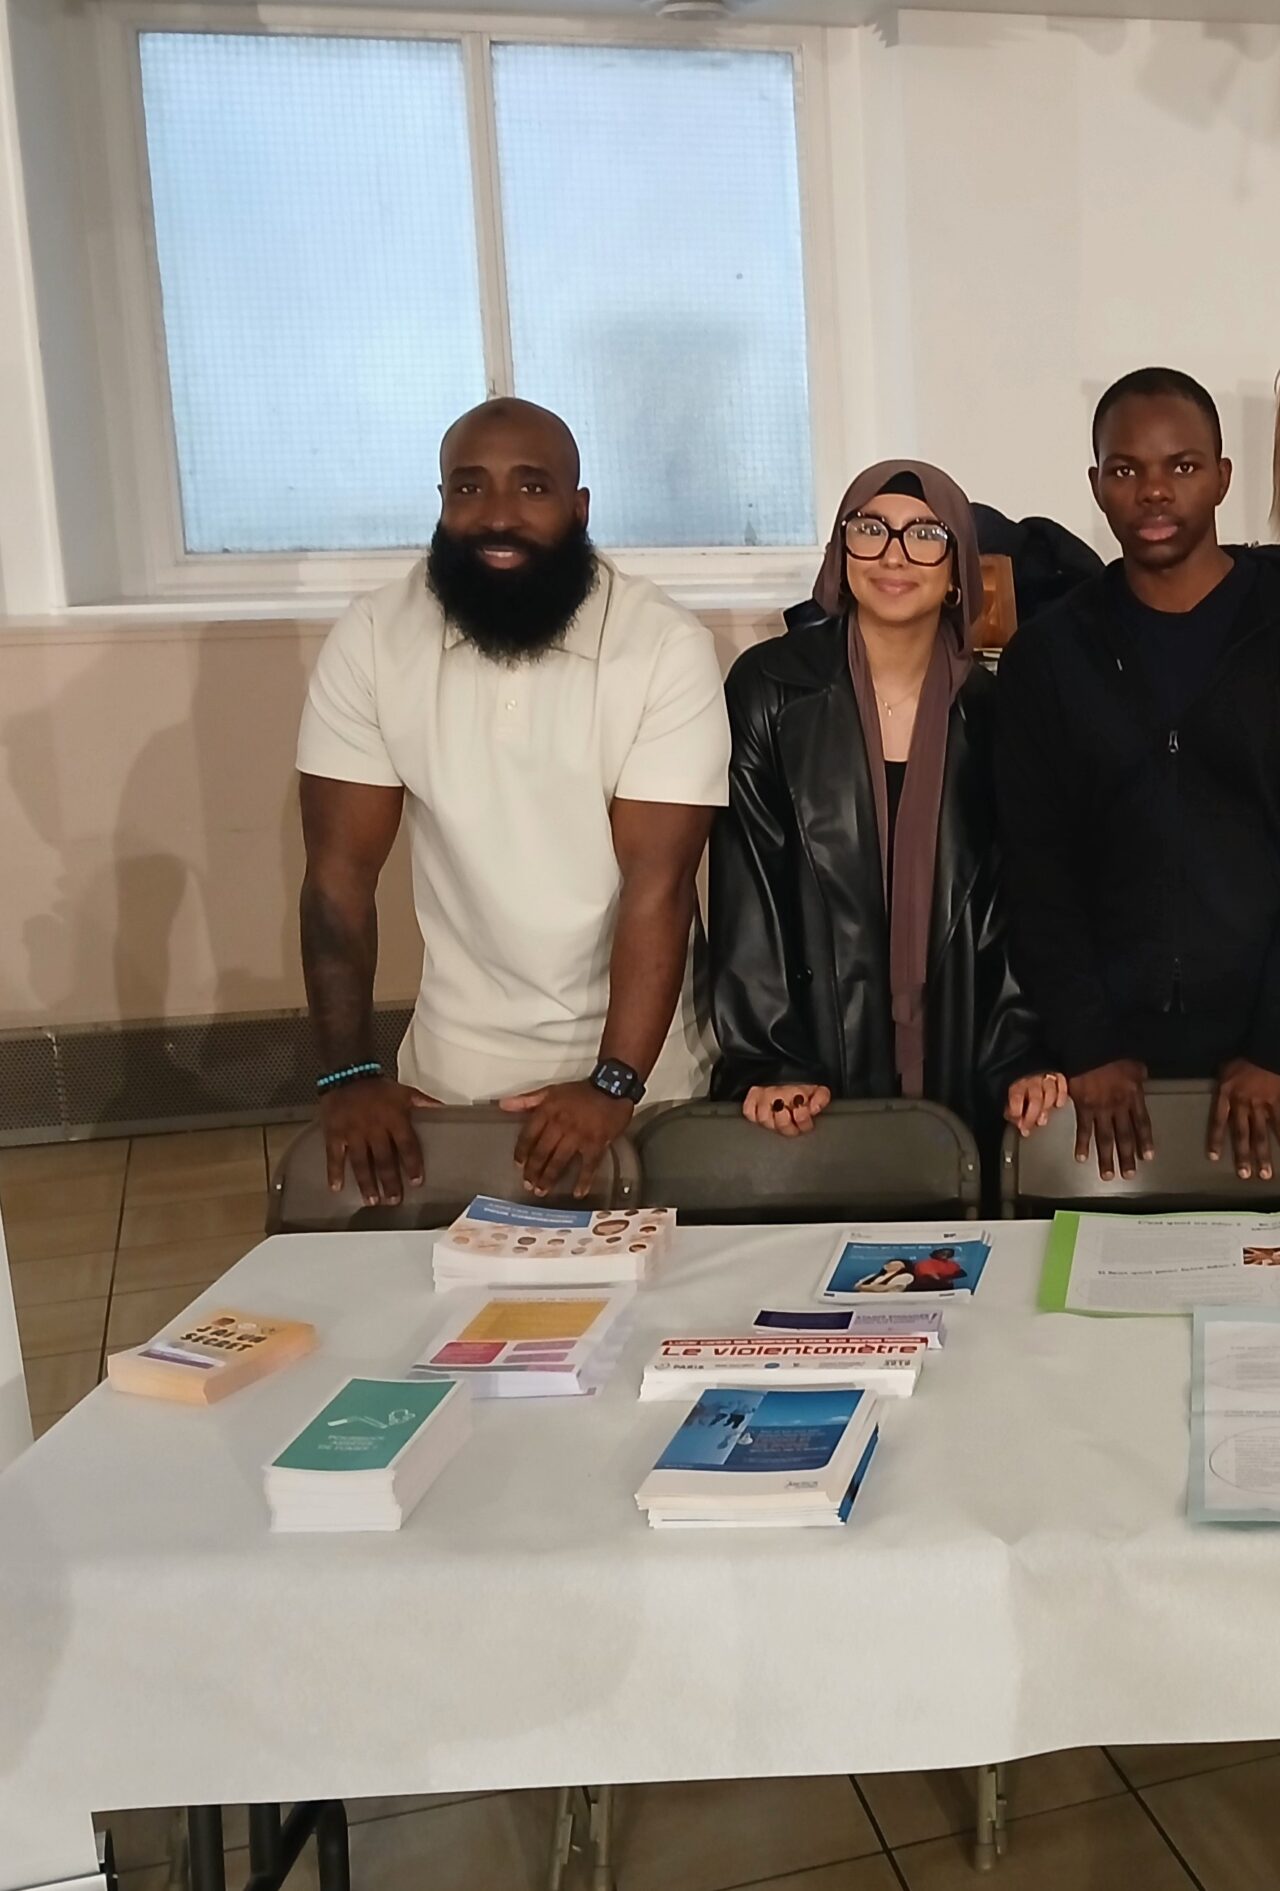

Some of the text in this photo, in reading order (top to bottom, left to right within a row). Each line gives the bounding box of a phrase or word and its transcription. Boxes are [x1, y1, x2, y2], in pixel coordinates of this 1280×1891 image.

[180, 1332, 254, 1352] SECRET
[662, 1346, 701, 1356] Le
[713, 1340, 918, 1356] violentomètre
